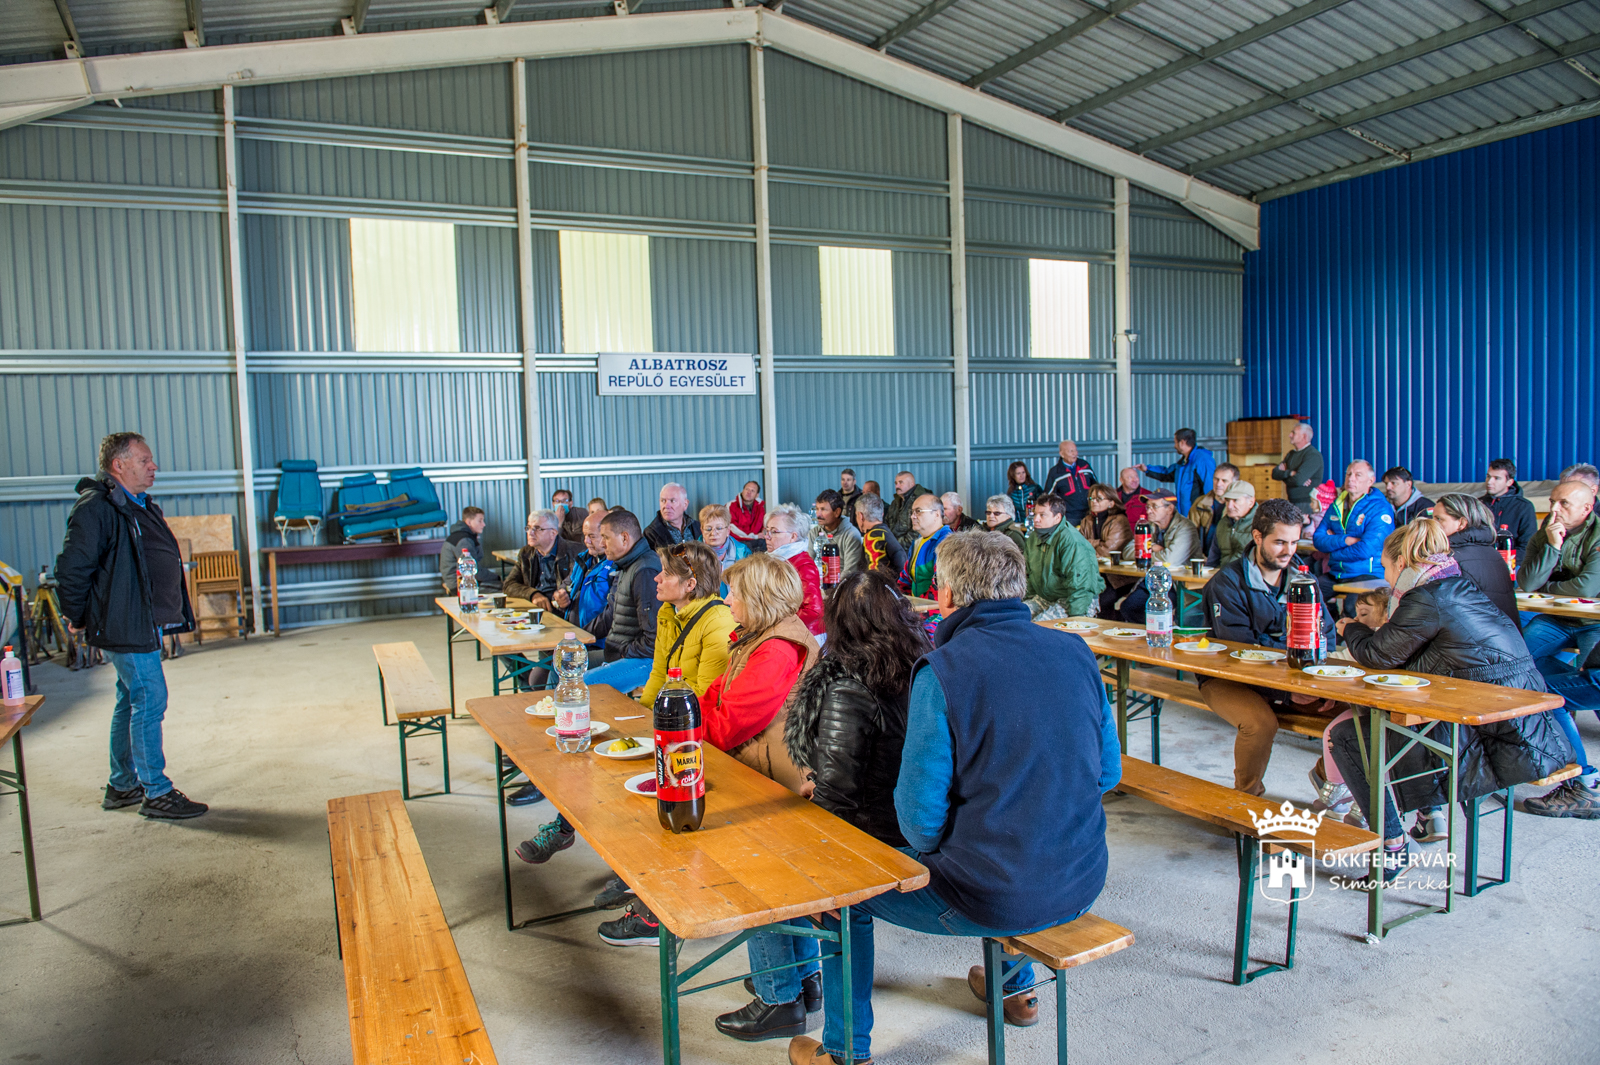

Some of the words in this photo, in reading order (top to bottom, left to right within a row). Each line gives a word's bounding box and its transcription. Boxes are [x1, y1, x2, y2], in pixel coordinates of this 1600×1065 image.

[628, 358, 728, 371] ALBATROSZ
[608, 372, 664, 387] REPÜLŐ
[669, 373, 746, 387] EGYESÜLET
[676, 755, 697, 767] MÁRKA
